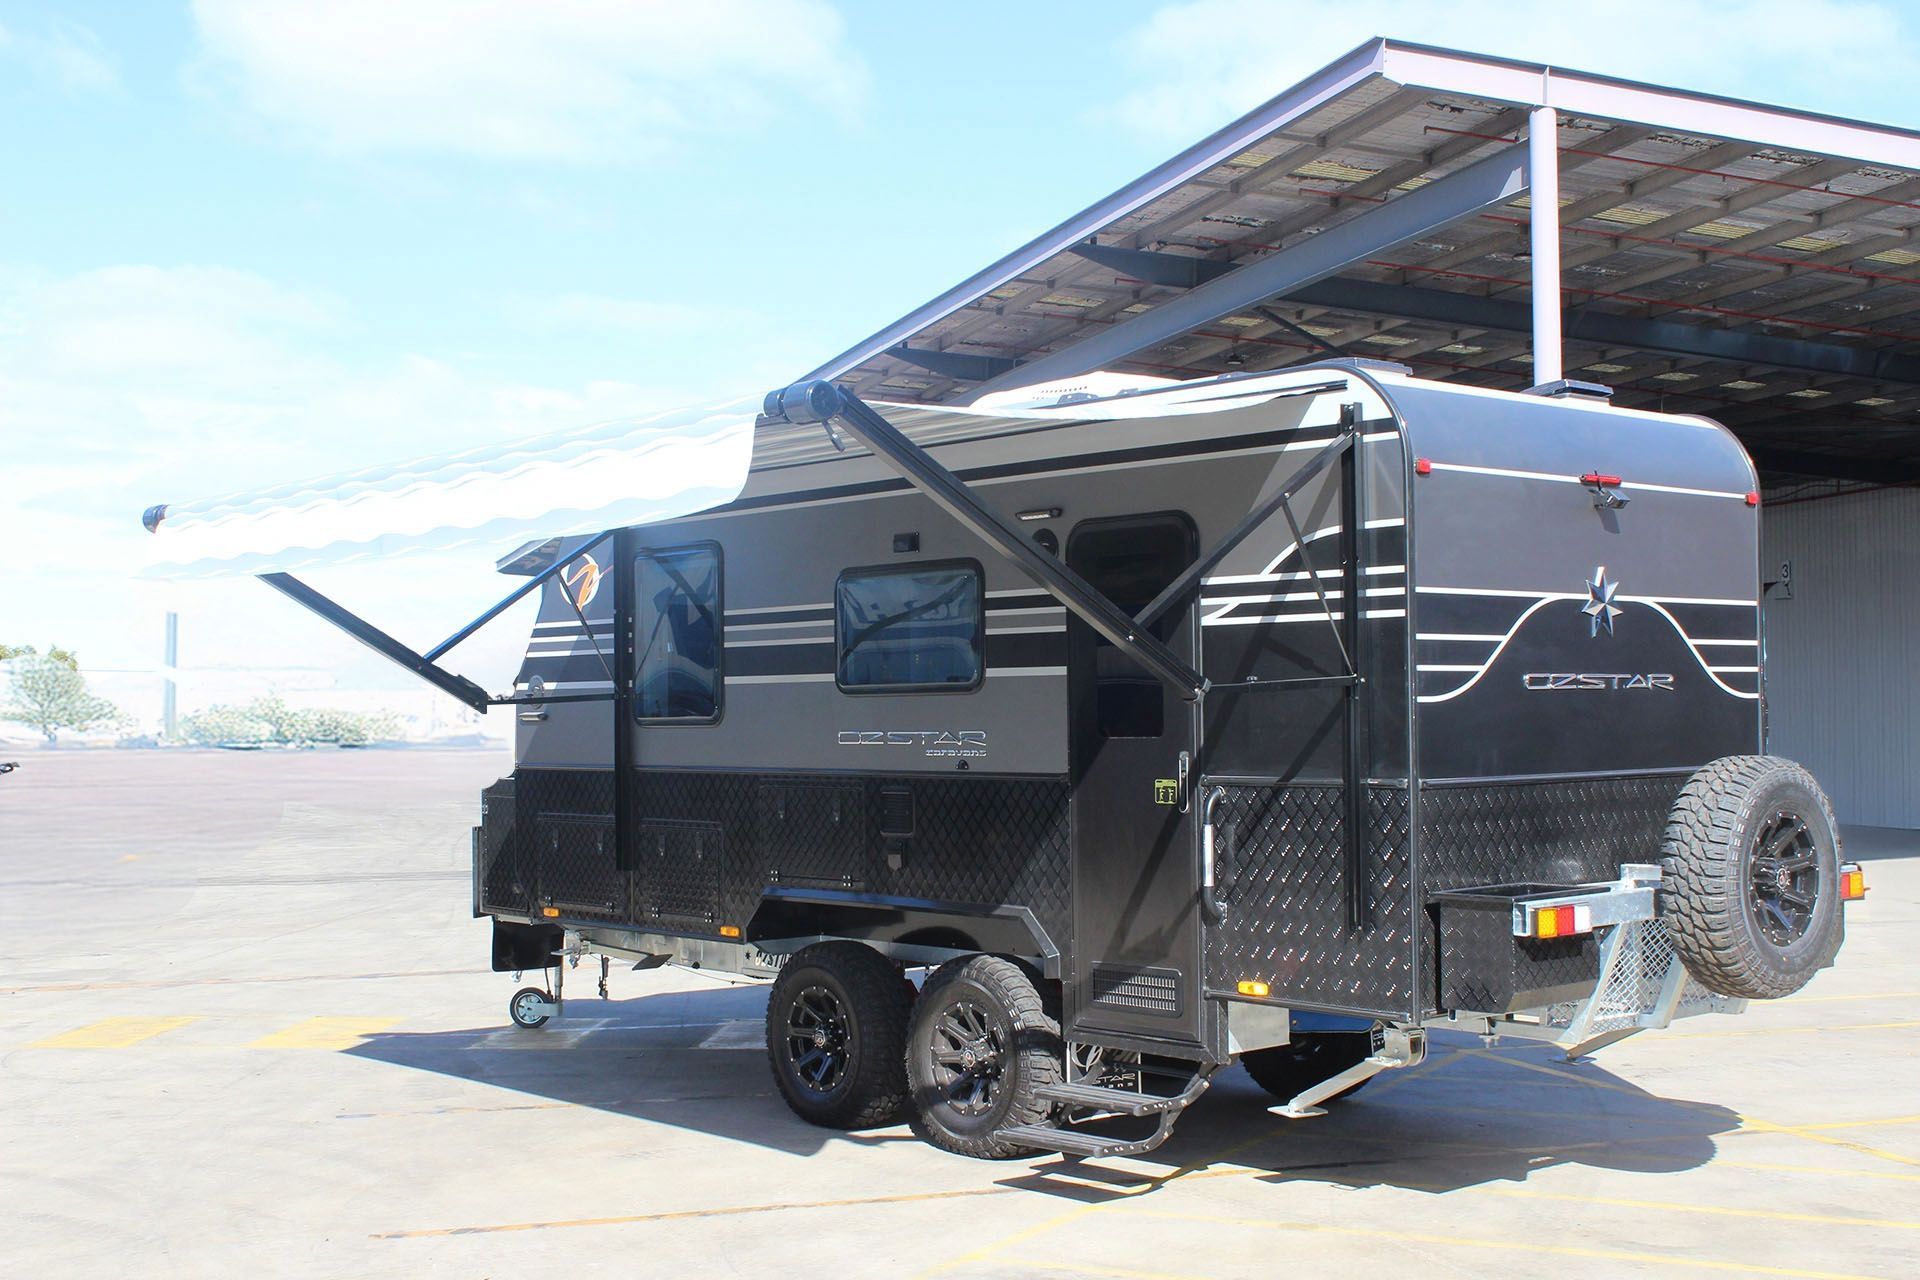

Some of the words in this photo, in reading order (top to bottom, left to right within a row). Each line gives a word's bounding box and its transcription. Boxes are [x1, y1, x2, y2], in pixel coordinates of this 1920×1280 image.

[1782, 563, 1789, 578] 3
[1523, 673, 1675, 690] OZSTAR
[838, 731, 987, 746] OZSTAR
